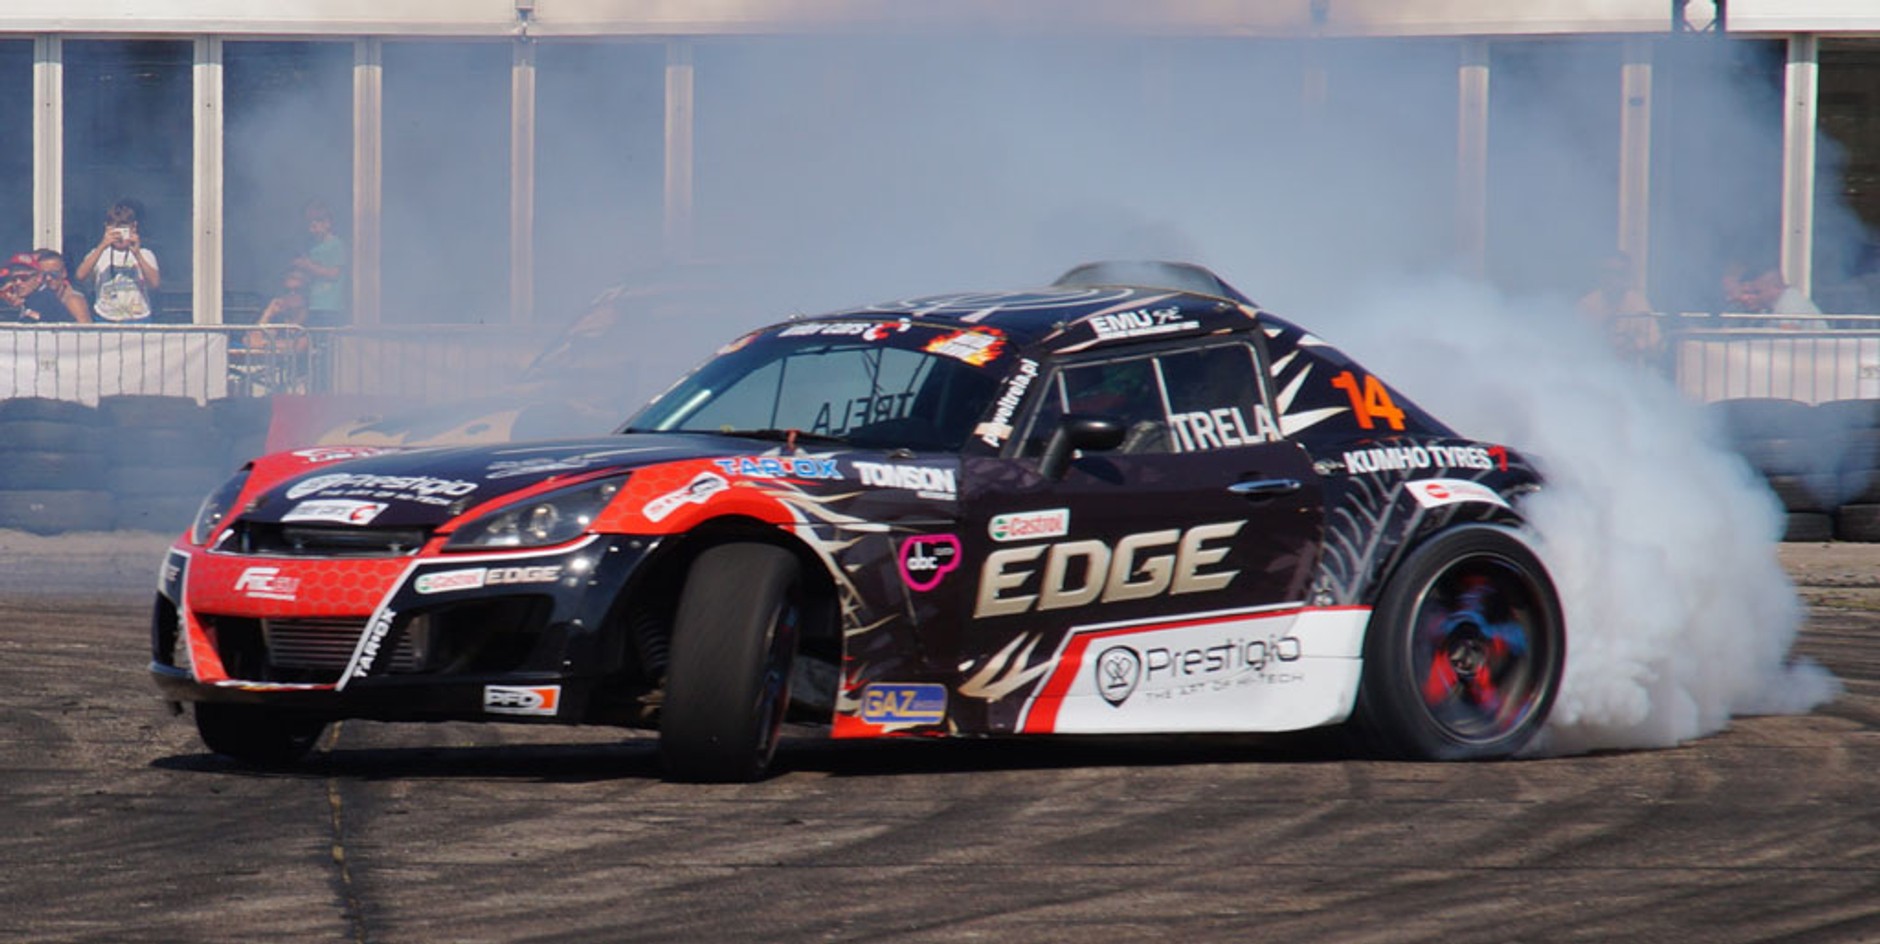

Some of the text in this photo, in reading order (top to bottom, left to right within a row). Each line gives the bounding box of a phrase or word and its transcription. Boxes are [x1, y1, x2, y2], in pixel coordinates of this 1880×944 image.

[1088, 309, 1153, 333] EMU
[1331, 370, 1406, 431] 14
[1170, 404, 1283, 453] TRELA
[1343, 445, 1494, 474] KUMHO TYRES
[852, 461, 956, 493] TOMSON
[1009, 512, 1063, 536] Castrol
[485, 565, 563, 585] EDGE
[973, 519, 1248, 619] EDGE
[1146, 634, 1302, 681] Prestigio
[864, 690, 918, 717] GAZ
